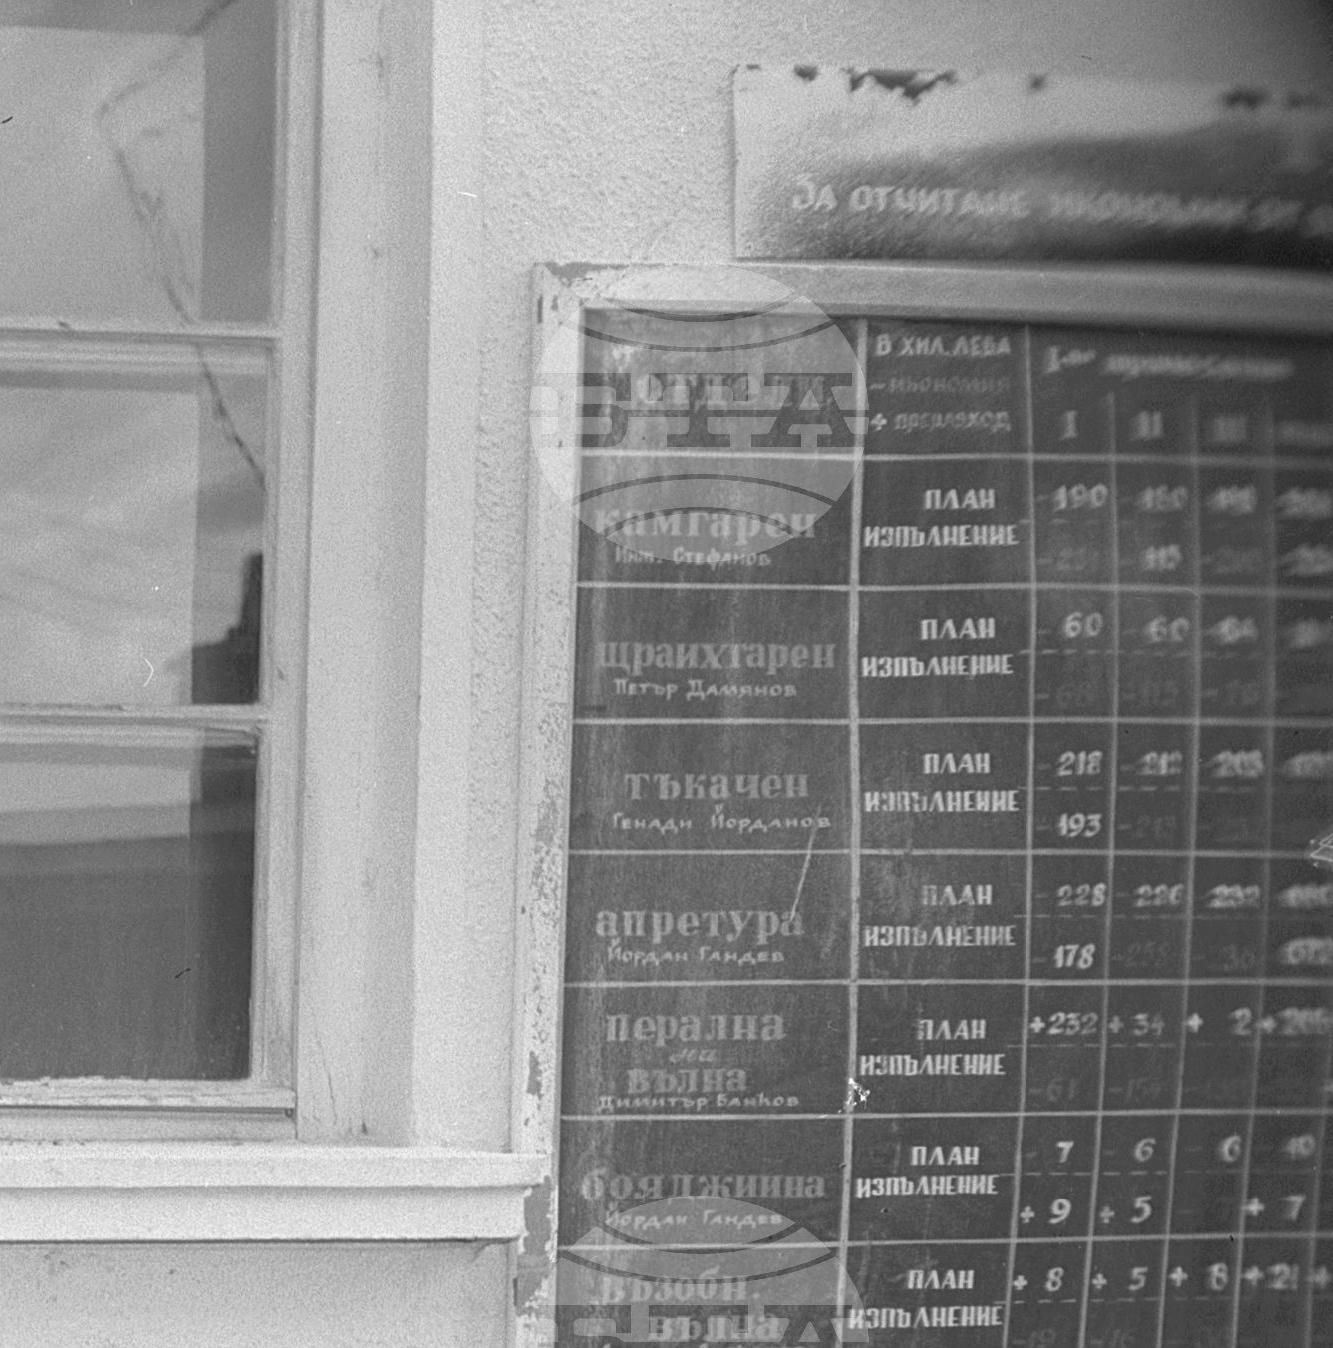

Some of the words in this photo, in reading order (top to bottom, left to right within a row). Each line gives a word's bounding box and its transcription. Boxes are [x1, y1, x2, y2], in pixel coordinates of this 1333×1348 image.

[923, 489, 996, 510] ПЛАН
[864, 524, 1021, 547] ИЗПЪЛНЕНИЕ
[920, 617, 996, 640] ПЛАН
[861, 653, 1014, 678] ИЗПЪЛНЕНИЕ
[923, 752, 991, 774] ПЛАН
[1057, 750, 1103, 776] 218
[864, 790, 1020, 813] ИЗПЪЛНЕНИЕ
[1058, 812, 1102, 838] 193
[921, 884, 993, 906] ПЛАН
[1056, 882, 1108, 907] 228
[594, 909, 805, 946] апретура
[863, 925, 1017, 948] ИЗПЪЛНЕНИЕ
[1054, 943, 1096, 970] 178
[605, 1013, 787, 1048] перална
[917, 1018, 987, 1041] ПЛАН
[859, 1053, 1006, 1076] ИЗПЪЛНЕНИЕ
[911, 1145, 980, 1167] ПЛАН
[856, 1175, 998, 1199] ИЗПЪЛНЕНИЕ
[907, 1269, 975, 1290] ПЛАН
[849, 1305, 1003, 1329] ИЗПЪЛНЕНИЕ
